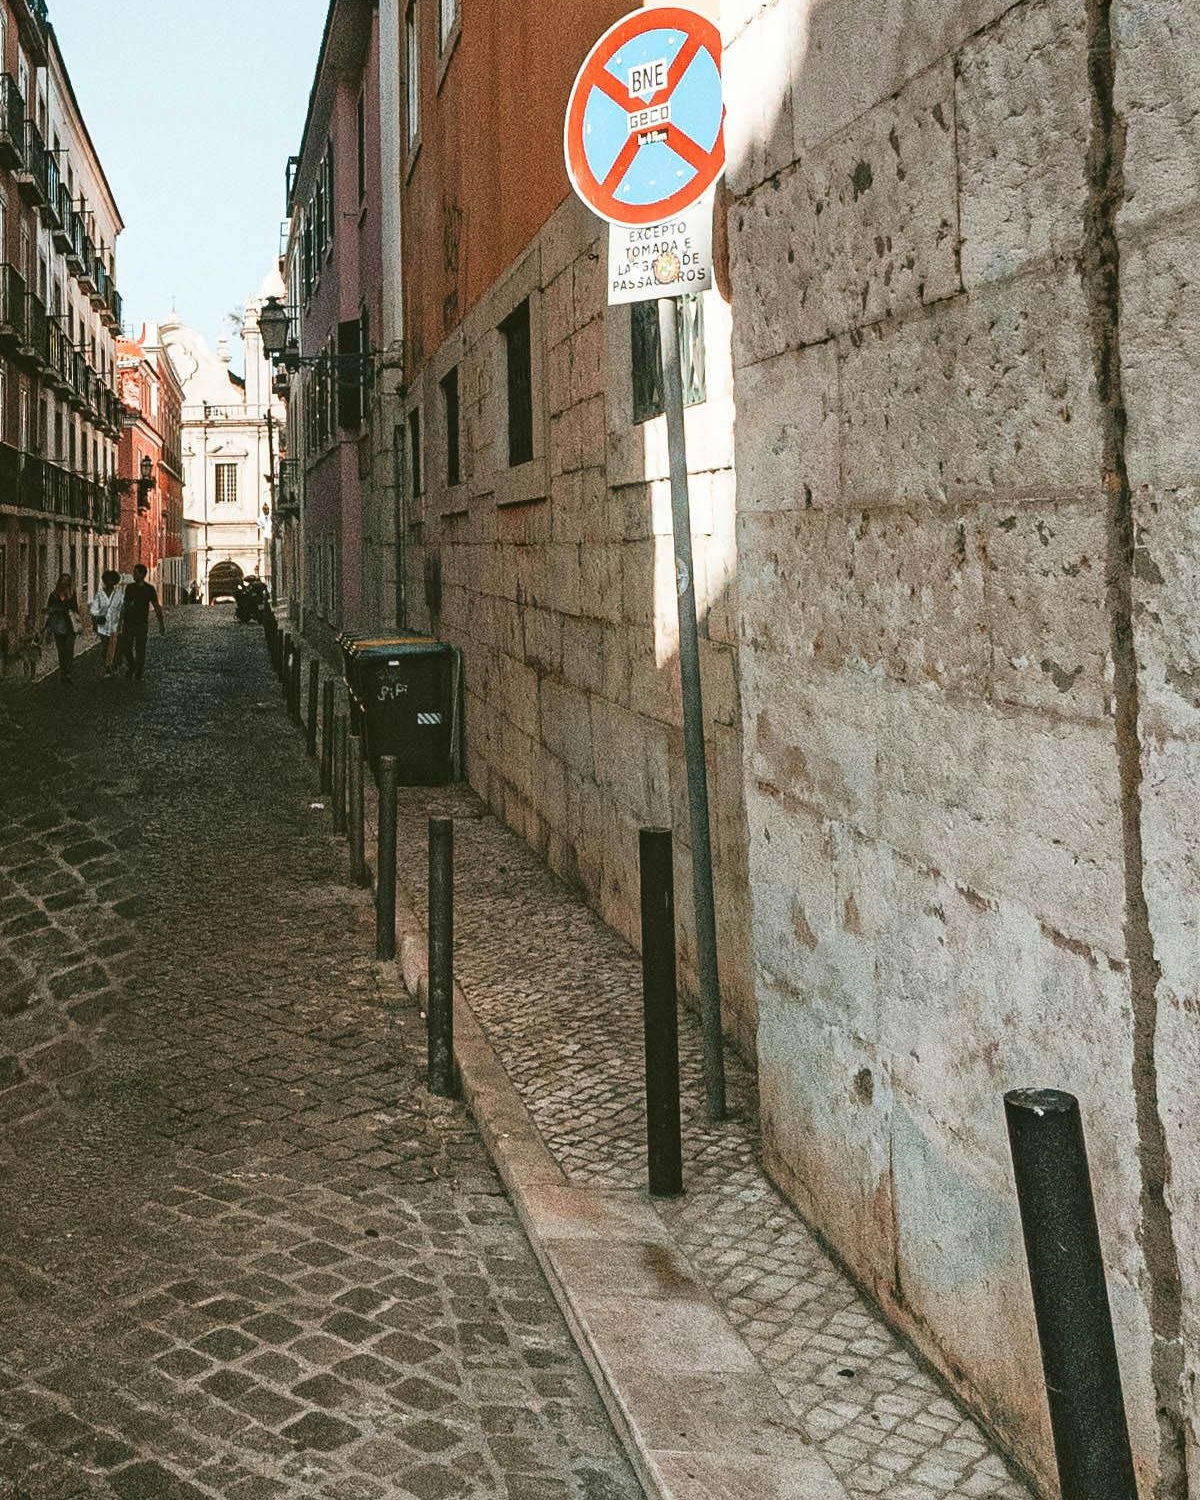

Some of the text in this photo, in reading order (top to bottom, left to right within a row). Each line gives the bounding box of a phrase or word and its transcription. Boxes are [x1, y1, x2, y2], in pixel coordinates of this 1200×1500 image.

[632, 63, 664, 92] BNE
[629, 221, 687, 243] EXCEPTO
[626, 237, 692, 259] TOMADA E
[682, 252, 700, 266] DE
